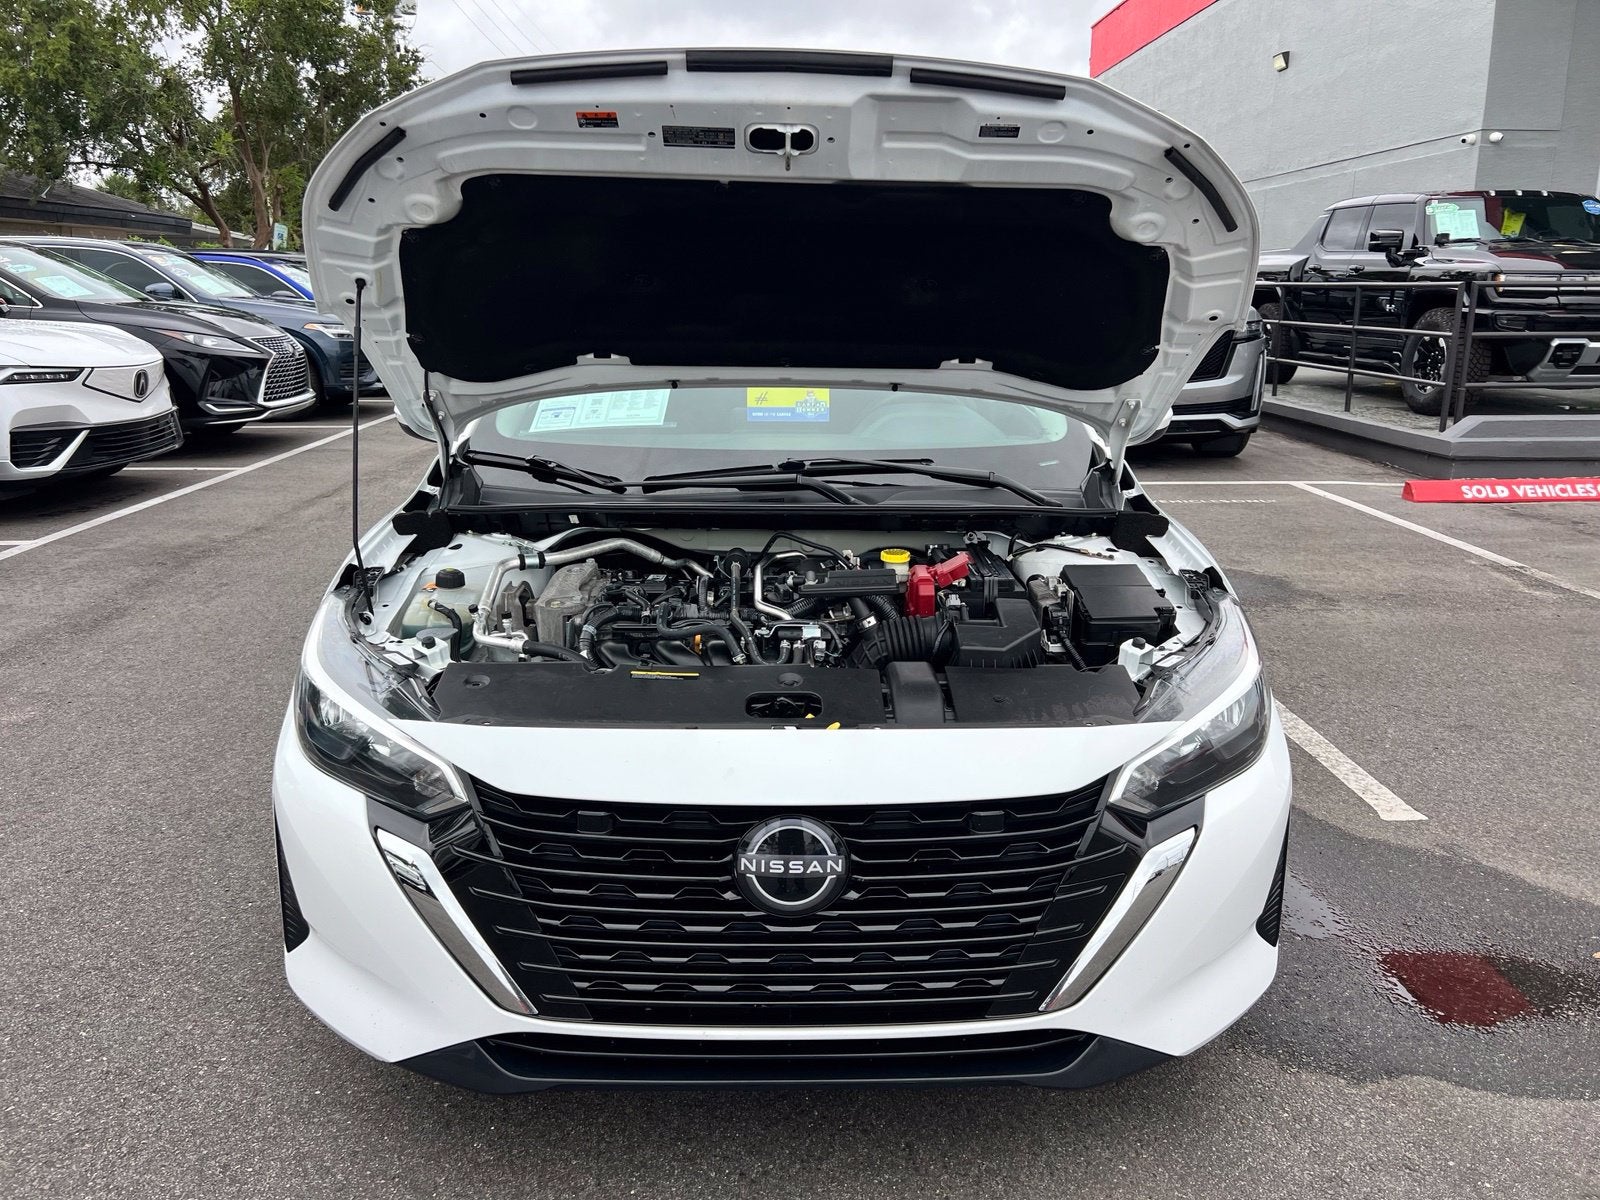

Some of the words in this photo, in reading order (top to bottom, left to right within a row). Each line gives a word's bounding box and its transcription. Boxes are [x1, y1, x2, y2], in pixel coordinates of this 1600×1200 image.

[1461, 485, 1509, 499] SOLD
[1512, 483, 1598, 498] VEHICLES
[740, 857, 842, 874] NISSAN
